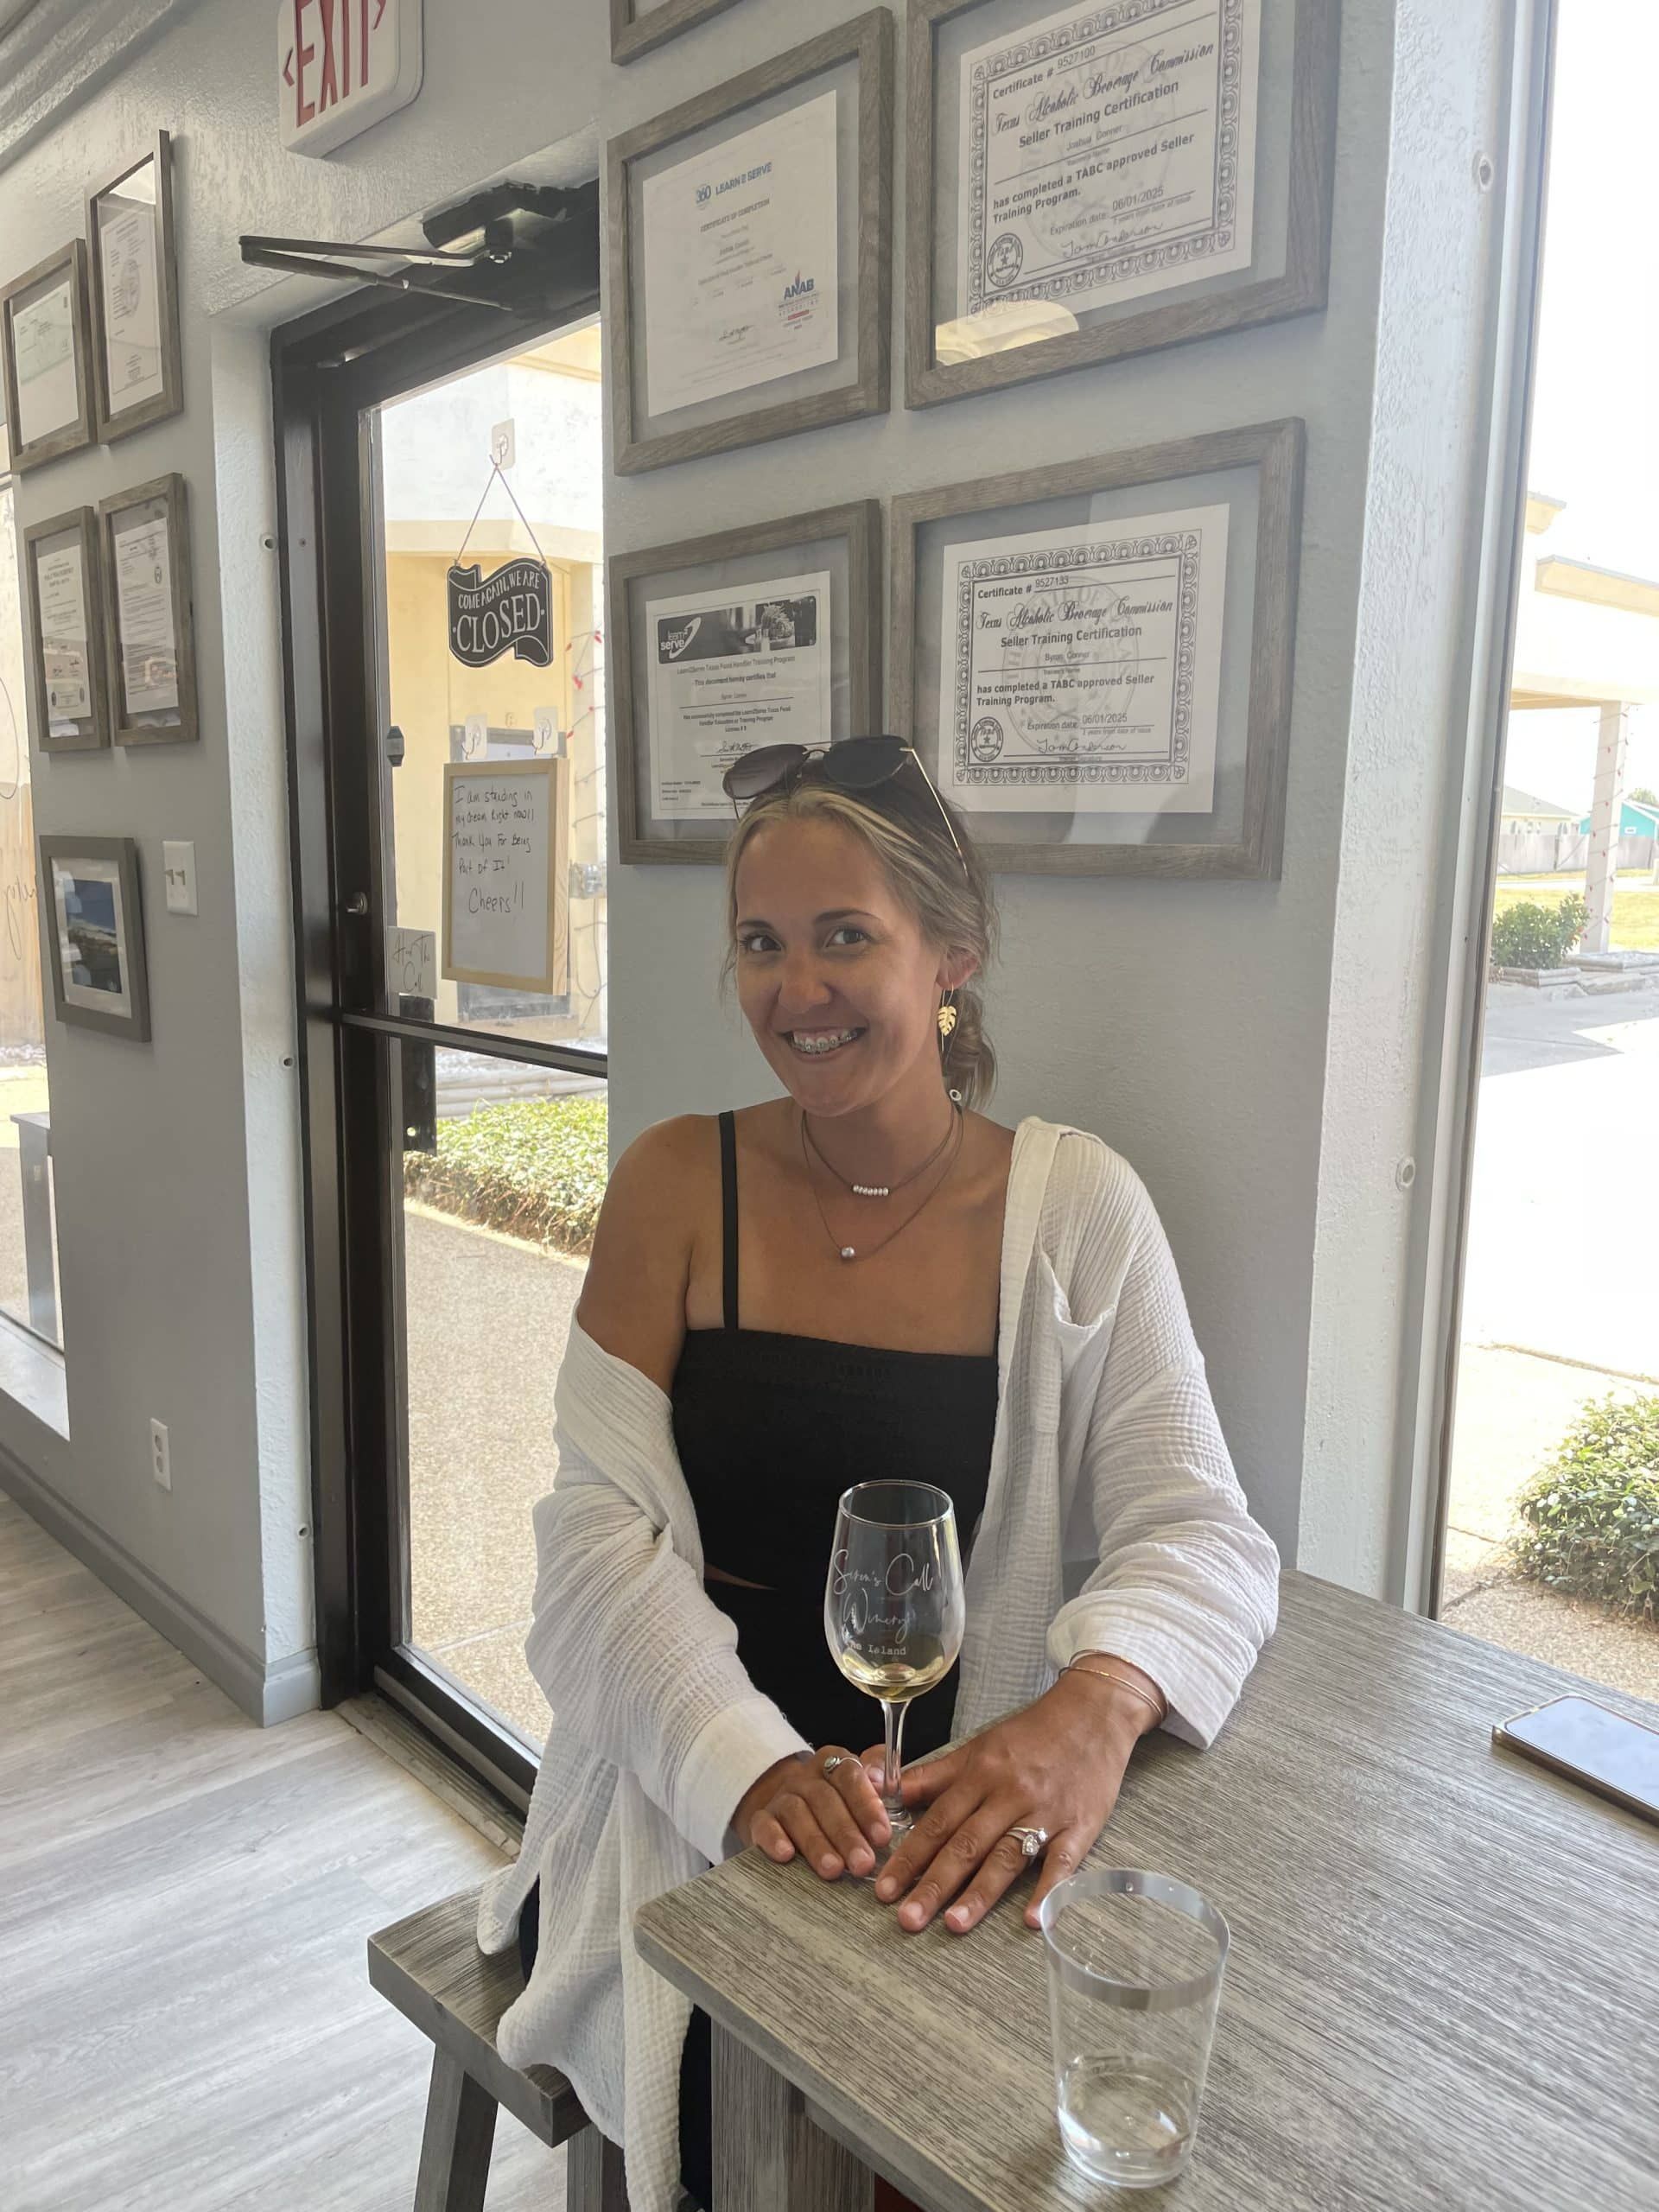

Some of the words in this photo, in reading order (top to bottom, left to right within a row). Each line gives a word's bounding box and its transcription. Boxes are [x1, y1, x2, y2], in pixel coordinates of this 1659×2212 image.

[992, 112, 1020, 136] Texas
[1026, 86, 1078, 124] Alcoholic
[1083, 71, 1139, 99] Beverage
[1142, 43, 1214, 83] Commission
[993, 73, 1043, 99] Certificate
[1046, 67, 1054, 79] #
[1058, 45, 1096, 69] 9527100
[1019, 129, 1051, 148] Seller
[1053, 110, 1101, 135] Training
[1104, 81, 1179, 117] Certification
[696, 184, 712, 204] 360
[715, 175, 741, 196] LEARN
[747, 161, 772, 181] SERVE
[993, 196, 1010, 210] has
[1012, 175, 1064, 203] completed
[1066, 175, 1073, 185] a
[1076, 162, 1103, 181] TABC
[1106, 143, 1158, 171] approved
[1160, 133, 1195, 152] Seller
[993, 204, 1033, 225] Training
[1035, 188, 1082, 210] Program.
[1050, 217, 1088, 236] Expiration
[1112, 185, 1164, 212] 06/01/2025
[784, 277, 815, 300] ANAB
[458, 593, 480, 610] COME
[508, 569, 523, 588] WE
[522, 569, 540, 589] ARE
[977, 585, 1023, 599] Certificate
[1026, 583, 1032, 594] #
[456, 592, 541, 653] CLOSED
[976, 611, 1002, 630] Texas
[1007, 602, 1055, 632] Alcoholic
[1057, 600, 1108, 626] Beverage
[1109, 594, 1173, 622] Commission
[660, 639, 685, 651] serve
[1001, 636, 1029, 648] Seller
[1031, 632, 1073, 645] Training
[1076, 625, 1142, 641] Certification
[976, 685, 992, 694] has
[994, 680, 1040, 694] completed
[1042, 682, 1048, 690] a
[1050, 678, 1075, 689] TABC
[1077, 675, 1122, 690] approved
[1125, 674, 1155, 685] Seller
[976, 696, 1012, 707] Training
[1014, 694, 1056, 706] Program.
[1027, 721, 1060, 732] Expiration
[1082, 712, 1128, 724] 06/01/2025
[454, 785, 465, 804] I
[467, 790, 480, 804] am
[524, 790, 533, 803] in
[885, 1553, 934, 1596] Call
[868, 1644, 906, 1656] Island
